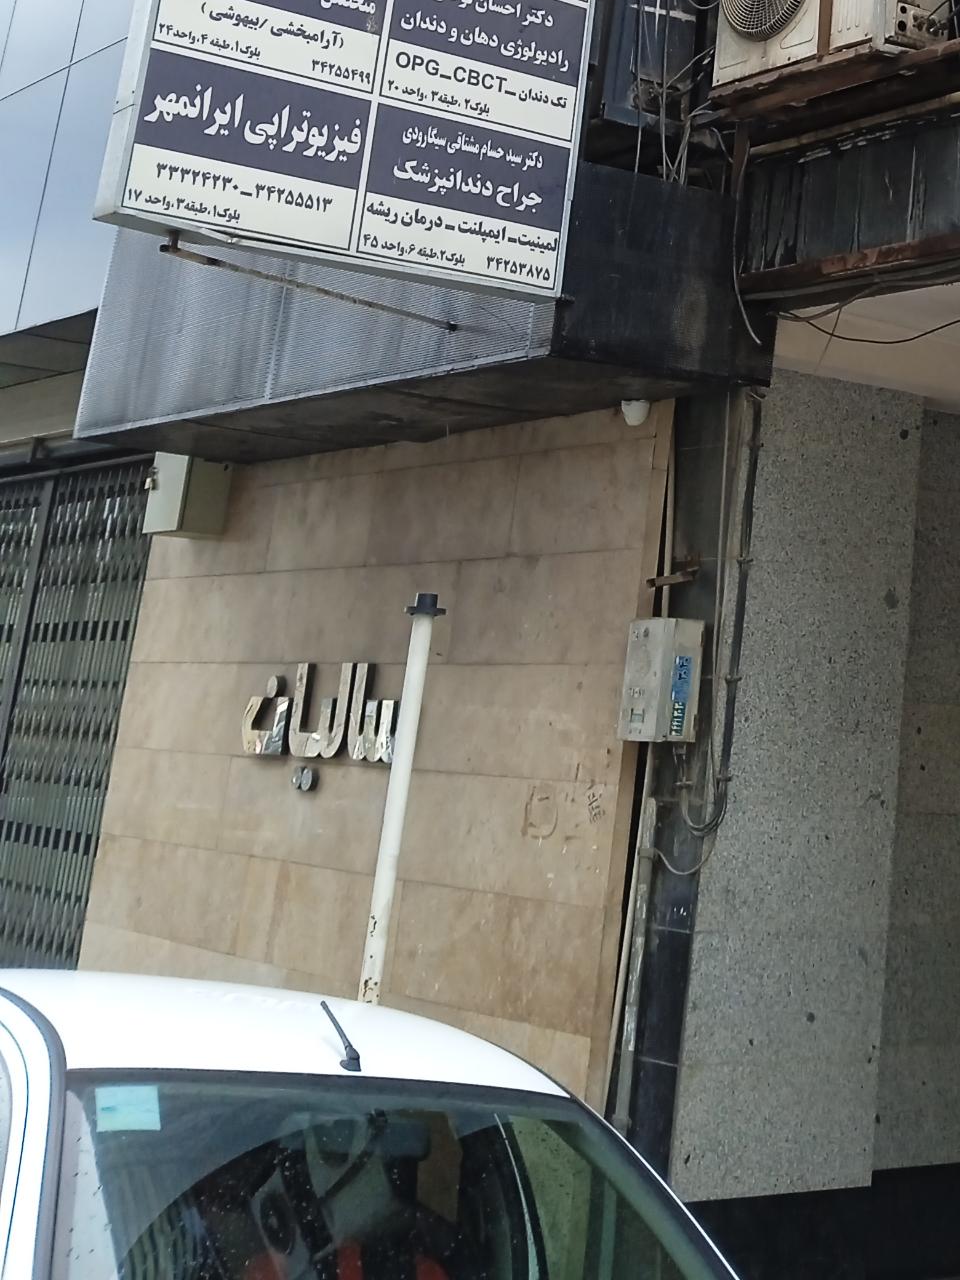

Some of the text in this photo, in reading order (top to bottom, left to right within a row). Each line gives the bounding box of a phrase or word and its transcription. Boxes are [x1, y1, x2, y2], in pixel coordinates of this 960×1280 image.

[521, 8, 554, 27] دکتر
[400, 11, 569, 72] رادیولوژی دهان و دندان
[311, 59, 371, 85] ۳۴۲۵۵۴۹۹
[388, 80, 399, 91] ۲۰
[519, 89, 549, 104] دندان
[551, 96, 567, 108] تک
[144, 83, 362, 162] فیزیوتراپی ایرانمهر
[402, 126, 543, 171] دکتر سید حسام مشتاقی سیگارودی
[128, 188, 142, 201] ۱۷
[393, 159, 542, 213] جراح دندانپزشک
[367, 201, 398, 224] ریشه
[401, 208, 443, 231] درمان
[364, 234, 379, 248] ۴۵
[458, 221, 506, 245] ایمپلنت
[487, 256, 550, 281] ۳۴۲۵۳۸۷۵
